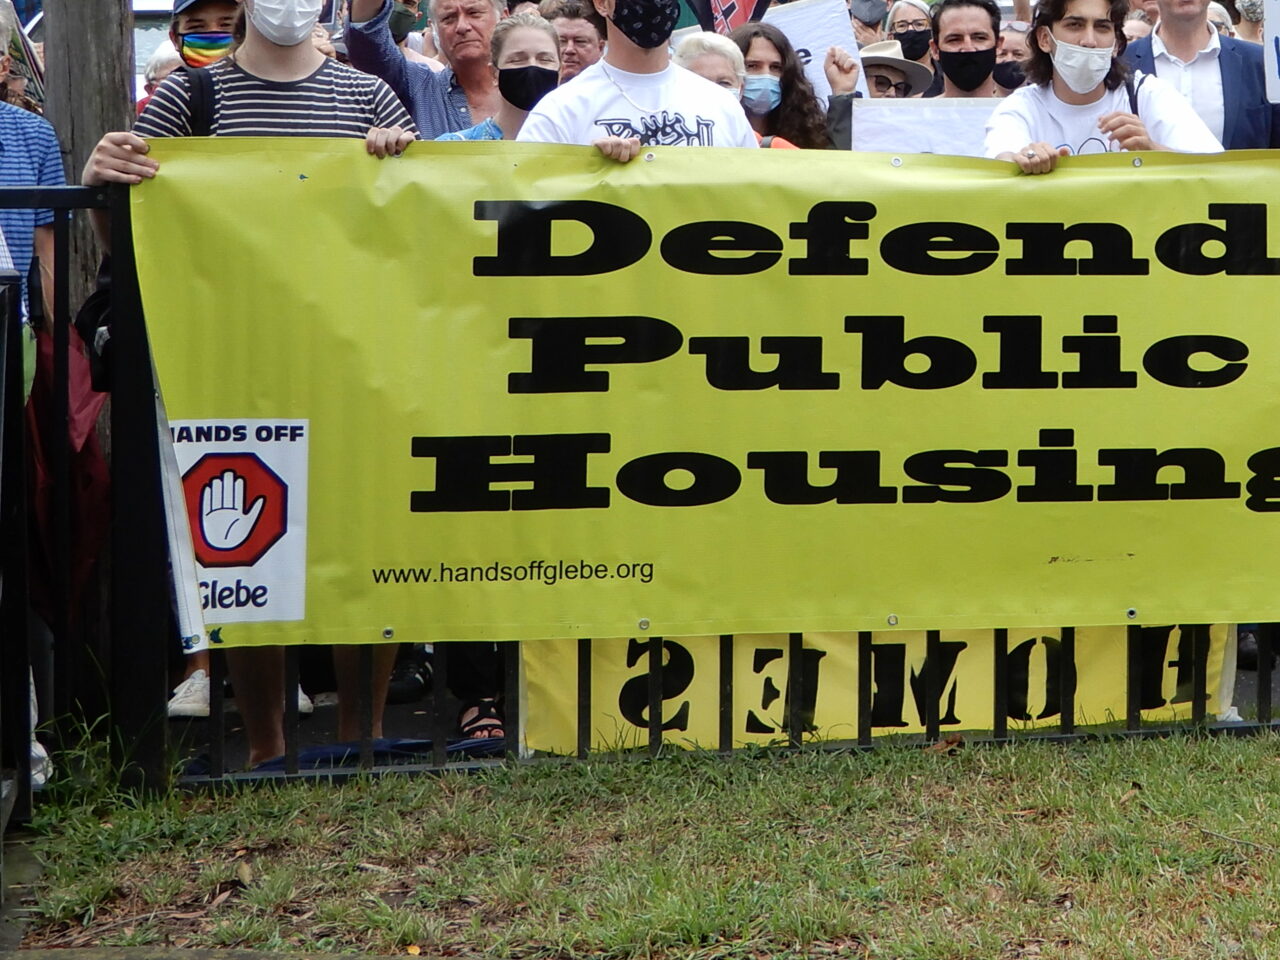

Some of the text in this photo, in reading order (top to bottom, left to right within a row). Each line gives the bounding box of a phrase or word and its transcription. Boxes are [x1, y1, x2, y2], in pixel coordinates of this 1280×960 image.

[508, 315, 1250, 394] Public
[172, 425, 304, 443] ANDS OFF
[373, 558, 655, 587] www.handsoffglebe.org
